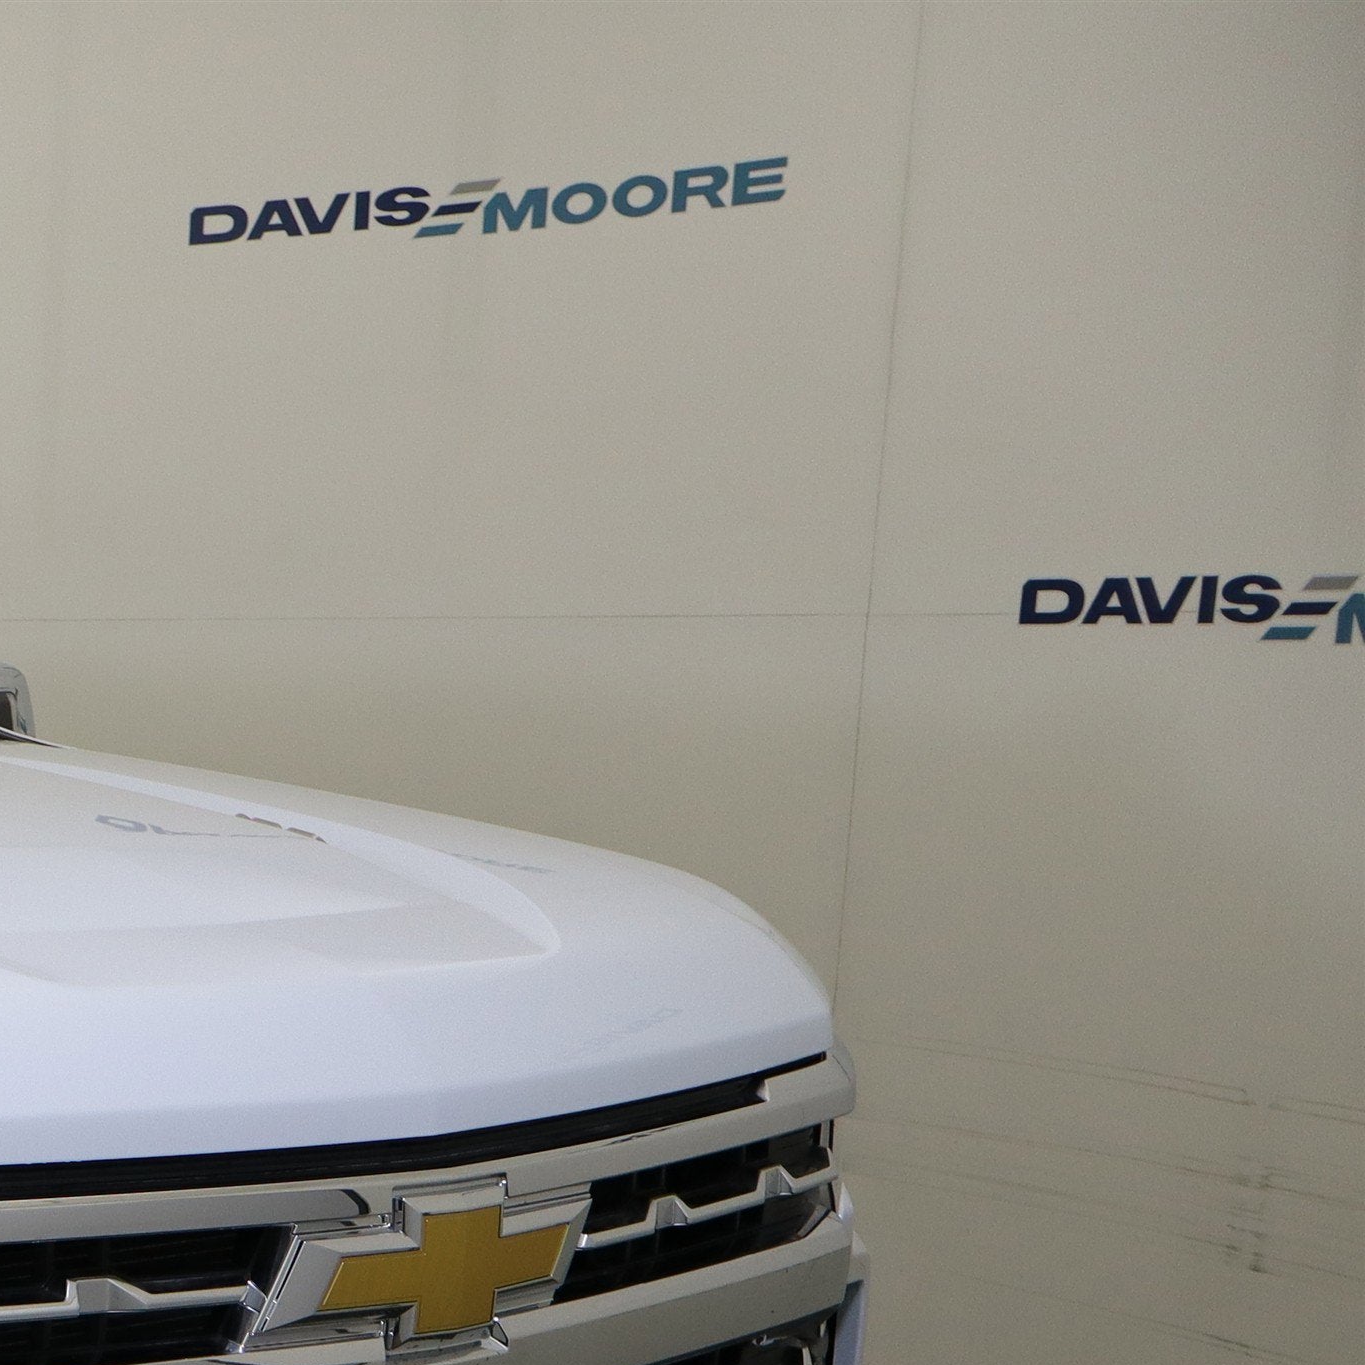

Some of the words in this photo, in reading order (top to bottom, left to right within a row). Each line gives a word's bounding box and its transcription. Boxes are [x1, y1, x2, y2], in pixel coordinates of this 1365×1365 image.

[188, 186, 430, 245] DAVIS
[482, 156, 789, 234] MOORE
[1018, 574, 1283, 625] DAVIS
